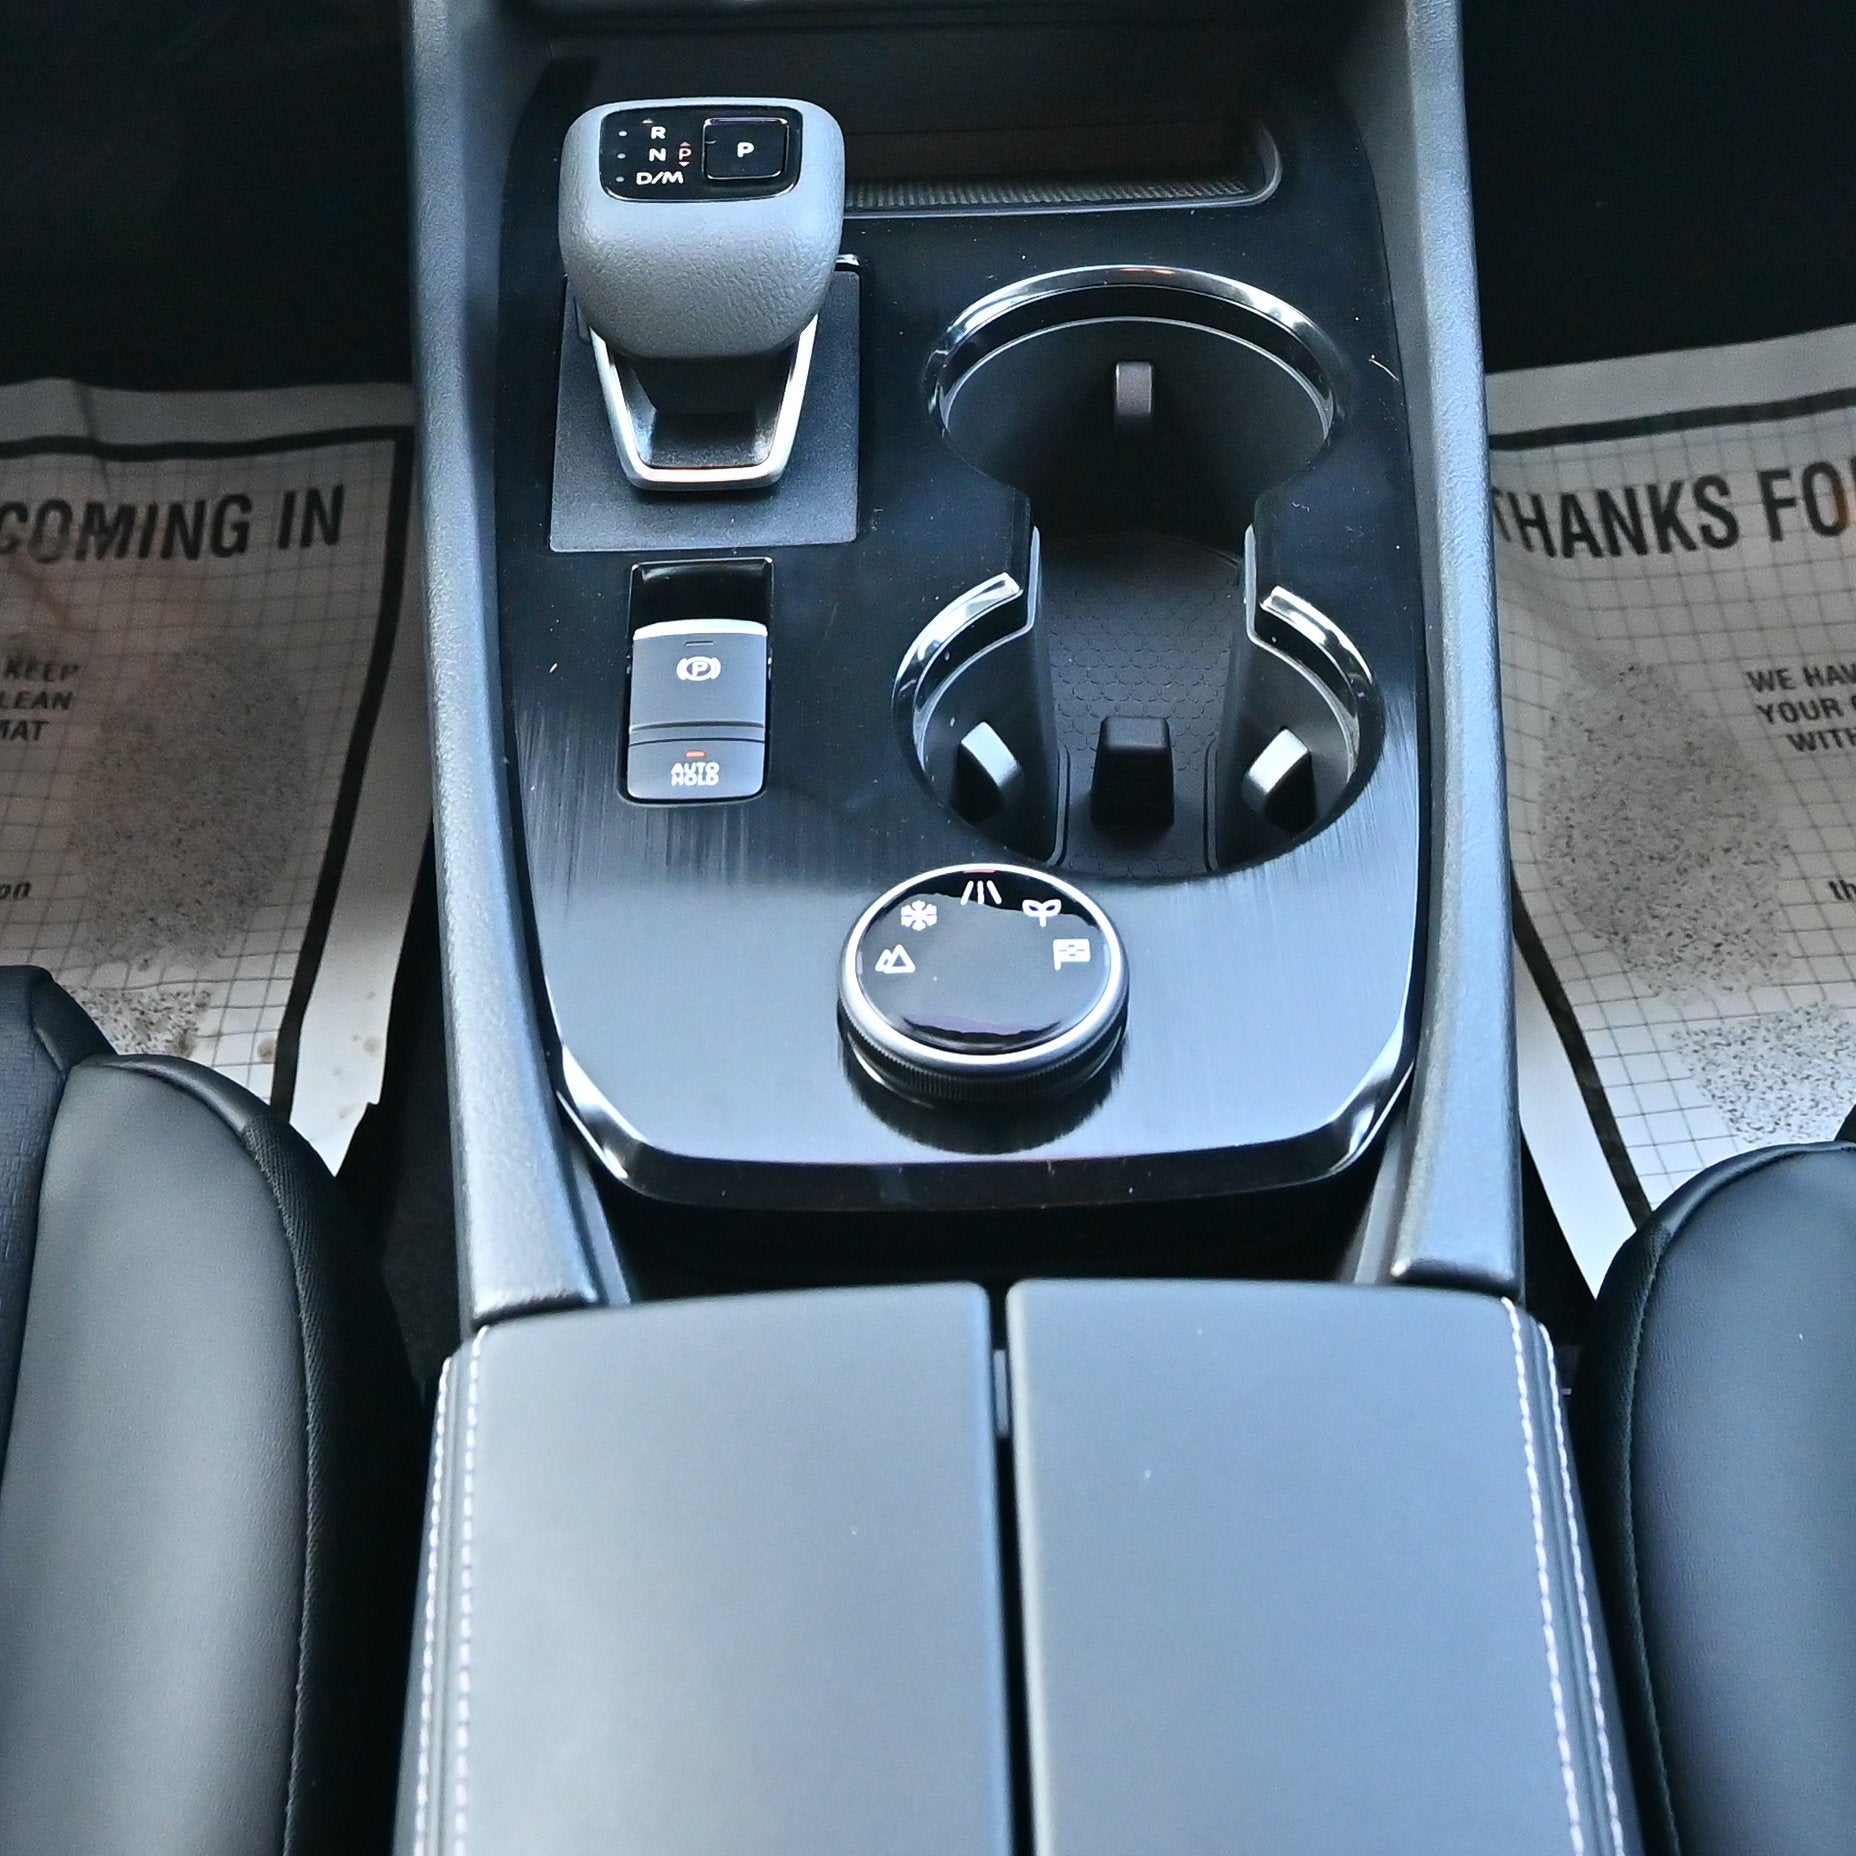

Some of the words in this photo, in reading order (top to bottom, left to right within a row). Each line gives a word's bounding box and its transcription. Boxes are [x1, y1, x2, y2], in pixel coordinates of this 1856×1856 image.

[650, 126, 667, 140] R
[649, 148, 667, 162] N
[678, 147, 692, 160] P
[737, 142, 755, 158] P
[635, 171, 684, 186] D/M
[277, 484, 345, 550] IN
[1491, 474, 1741, 559] THANKS
[3, 656, 81, 682] KEEP
[1747, 668, 1796, 693] WE
[1757, 697, 1844, 725] YOUR
[671, 762, 720, 775] AUTO
[671, 773, 719, 787] HOLD
